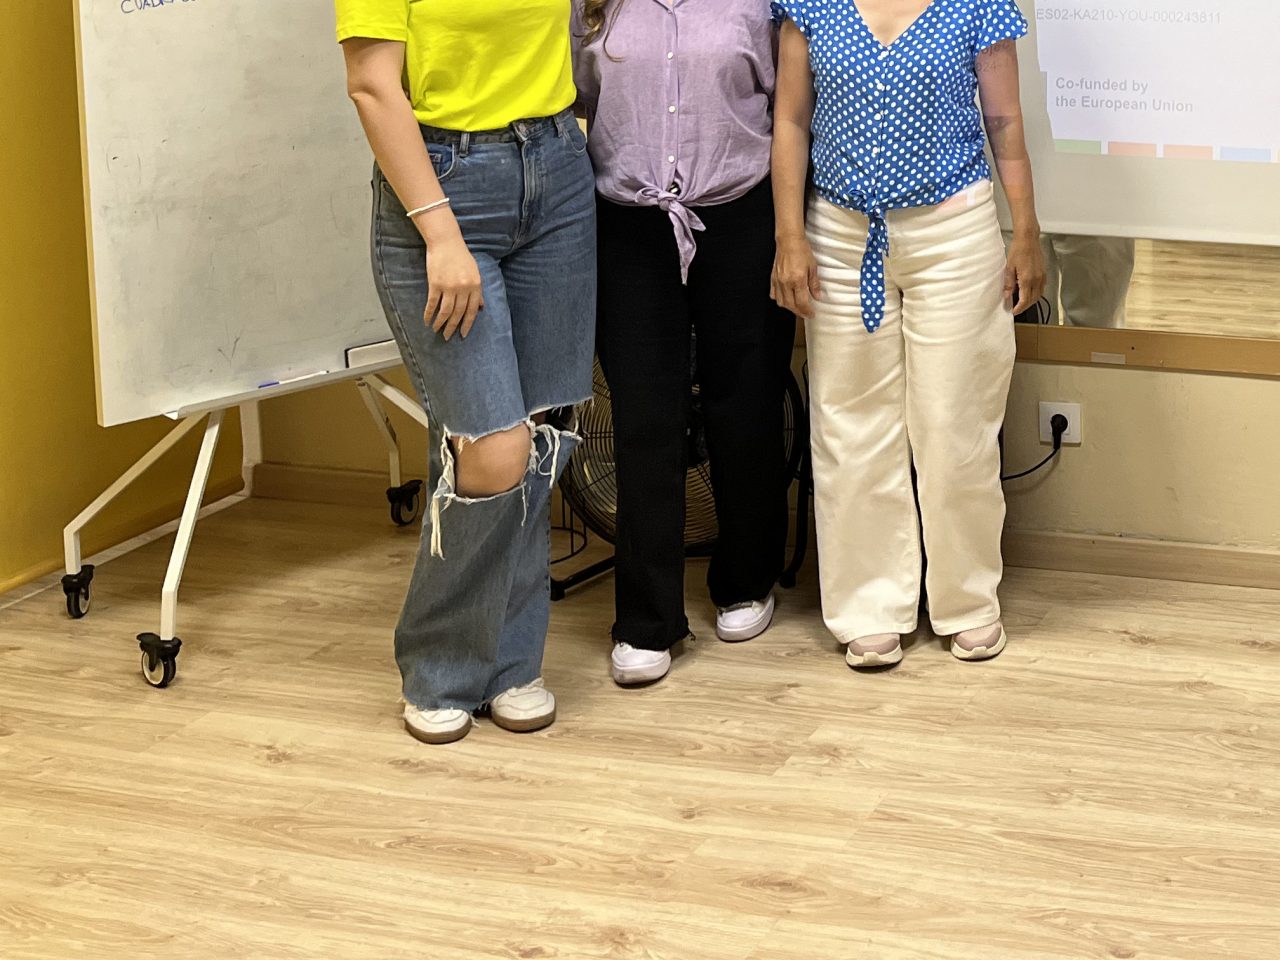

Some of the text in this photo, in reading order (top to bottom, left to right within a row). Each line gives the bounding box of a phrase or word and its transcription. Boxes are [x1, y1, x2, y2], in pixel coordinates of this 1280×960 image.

[1055, 77, 1149, 95] Co-funded by
[1055, 96, 1193, 113] the European Union
